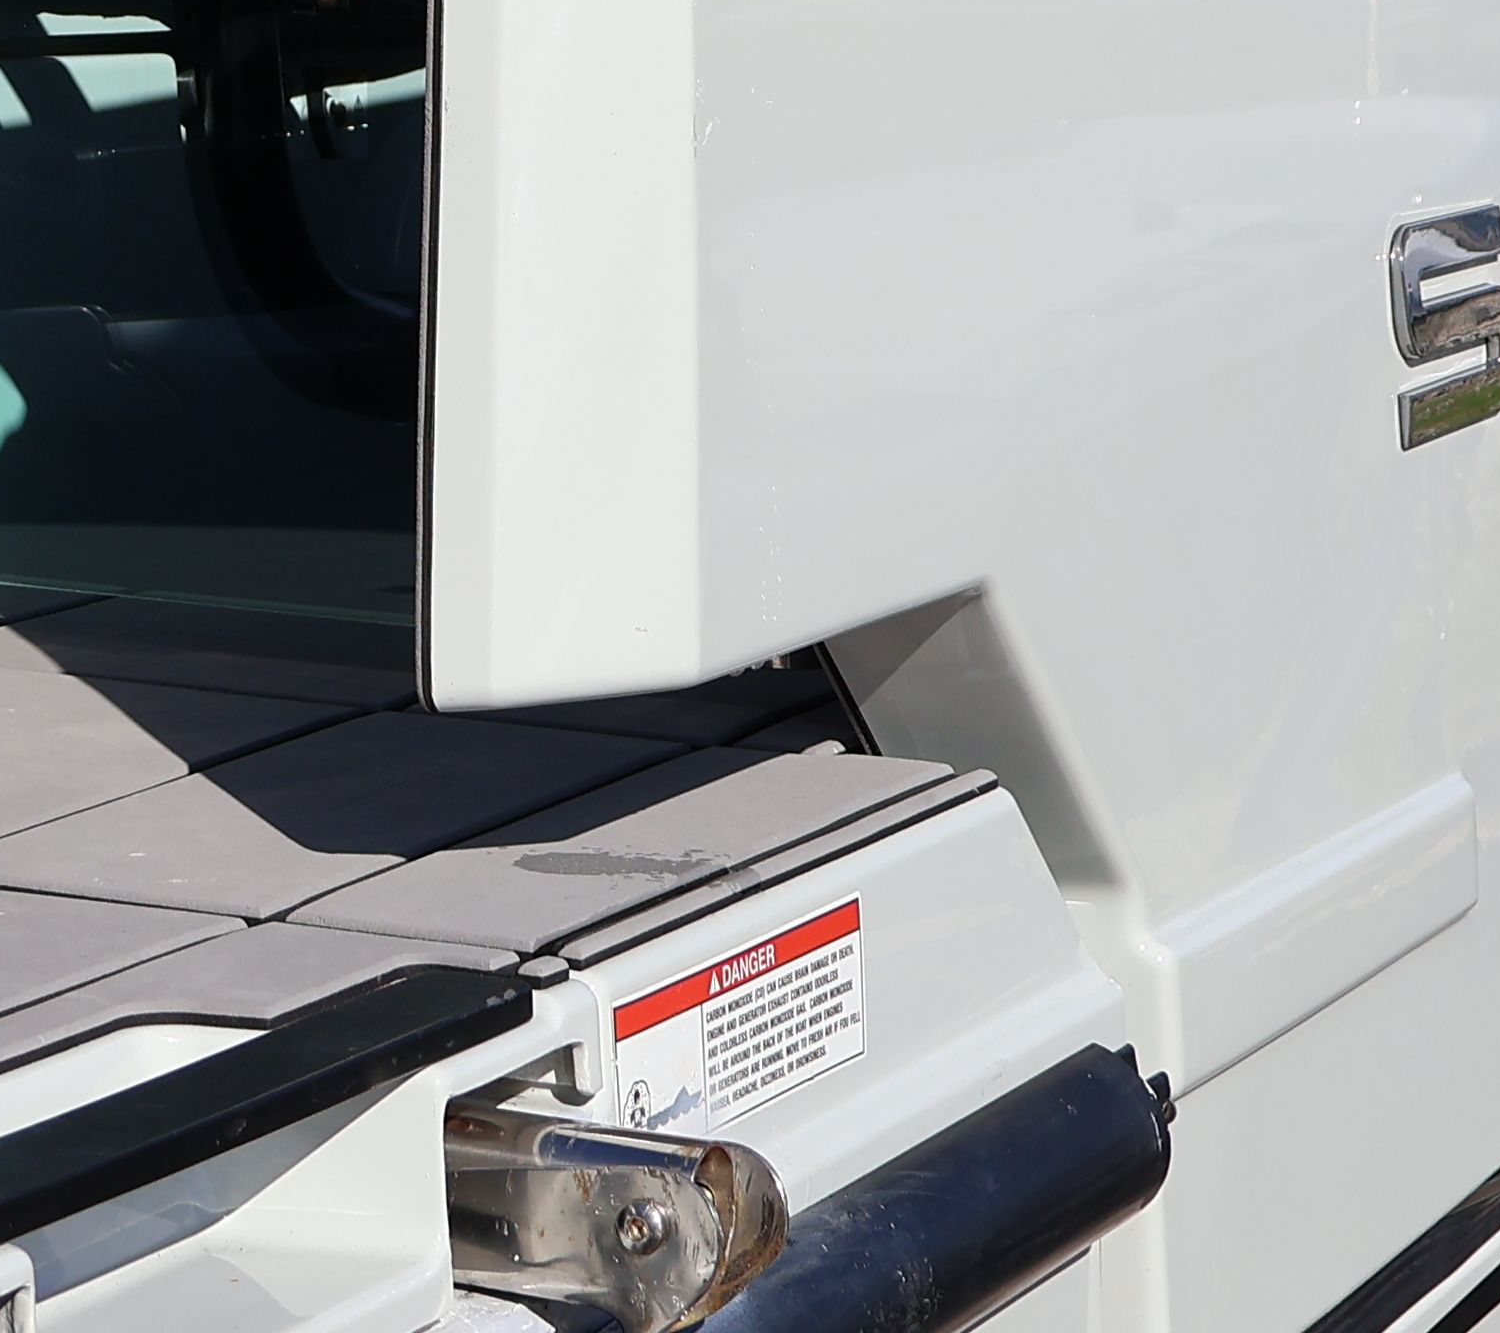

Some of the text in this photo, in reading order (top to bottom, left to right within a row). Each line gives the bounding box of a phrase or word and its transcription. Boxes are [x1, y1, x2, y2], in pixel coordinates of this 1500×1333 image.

[706, 1004, 726, 1024] CARBON
[766, 981, 776, 995] CAN
[777, 971, 793, 989] CAUSE
[795, 965, 809, 981] BRAIN
[810, 955, 829, 973] DAMAGE
[830, 951, 838, 964] OR
[722, 943, 776, 989] DANGER
[707, 1023, 725, 1042] ENGINE
[726, 1018, 737, 1033] AND
[738, 1003, 766, 1027] GENERATOR
[768, 991, 789, 1013] EXHAUST
[790, 981, 813, 1001] CONTAINS
[708, 1044, 718, 1061] AND
[719, 1030, 747, 1055] COLORLESS
[749, 1019, 769, 1041] CARBON
[809, 990, 828, 1009] CARBON
[708, 1001, 843, 1078] WILL BE AROUND THE BACK OF THE BOAT WHEN ENGINES
[718, 1066, 749, 1093] GENERATORS
[750, 1060, 760, 1075] ARE
[786, 1040, 800, 1056] MOVE
[801, 1036, 807, 1049] TO
[808, 1028, 824, 1046] FRESH
[825, 1023, 833, 1037] AIR
[834, 1021, 838, 1033] IF
[787, 1060, 794, 1074] OR
